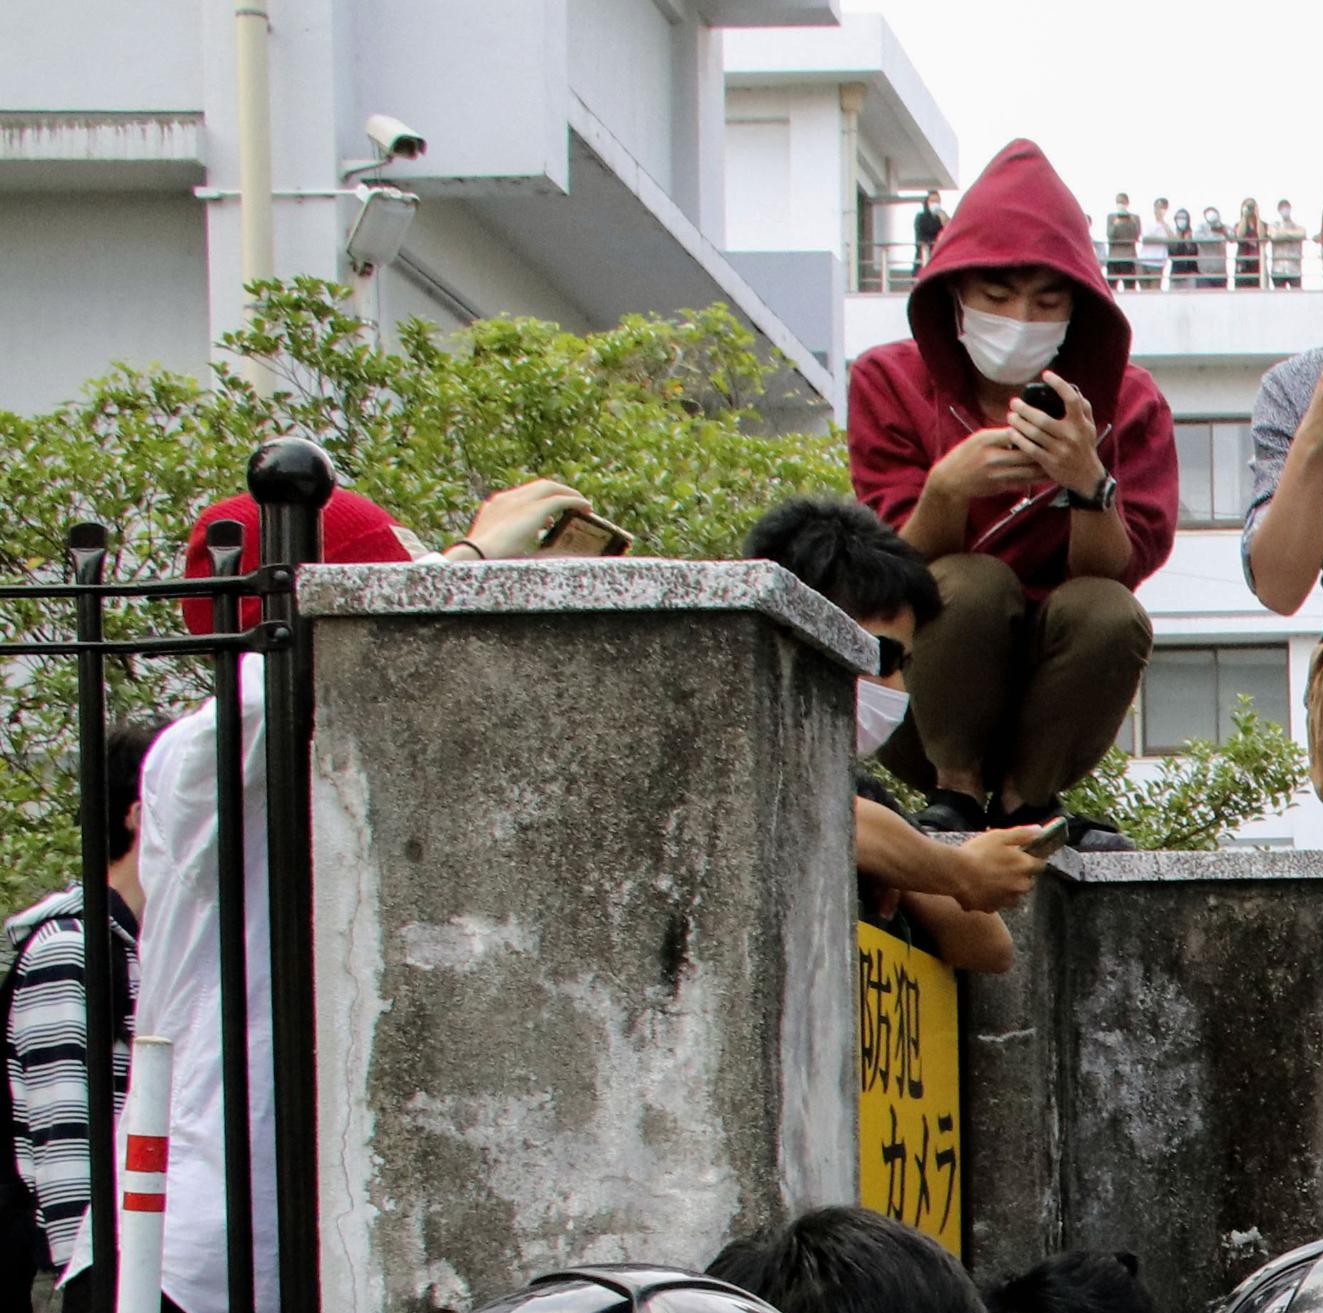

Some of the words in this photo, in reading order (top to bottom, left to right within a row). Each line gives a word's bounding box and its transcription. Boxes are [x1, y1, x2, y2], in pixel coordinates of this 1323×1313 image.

[859, 945, 925, 1100] 防犯
[882, 1103, 957, 1235] カメラ
